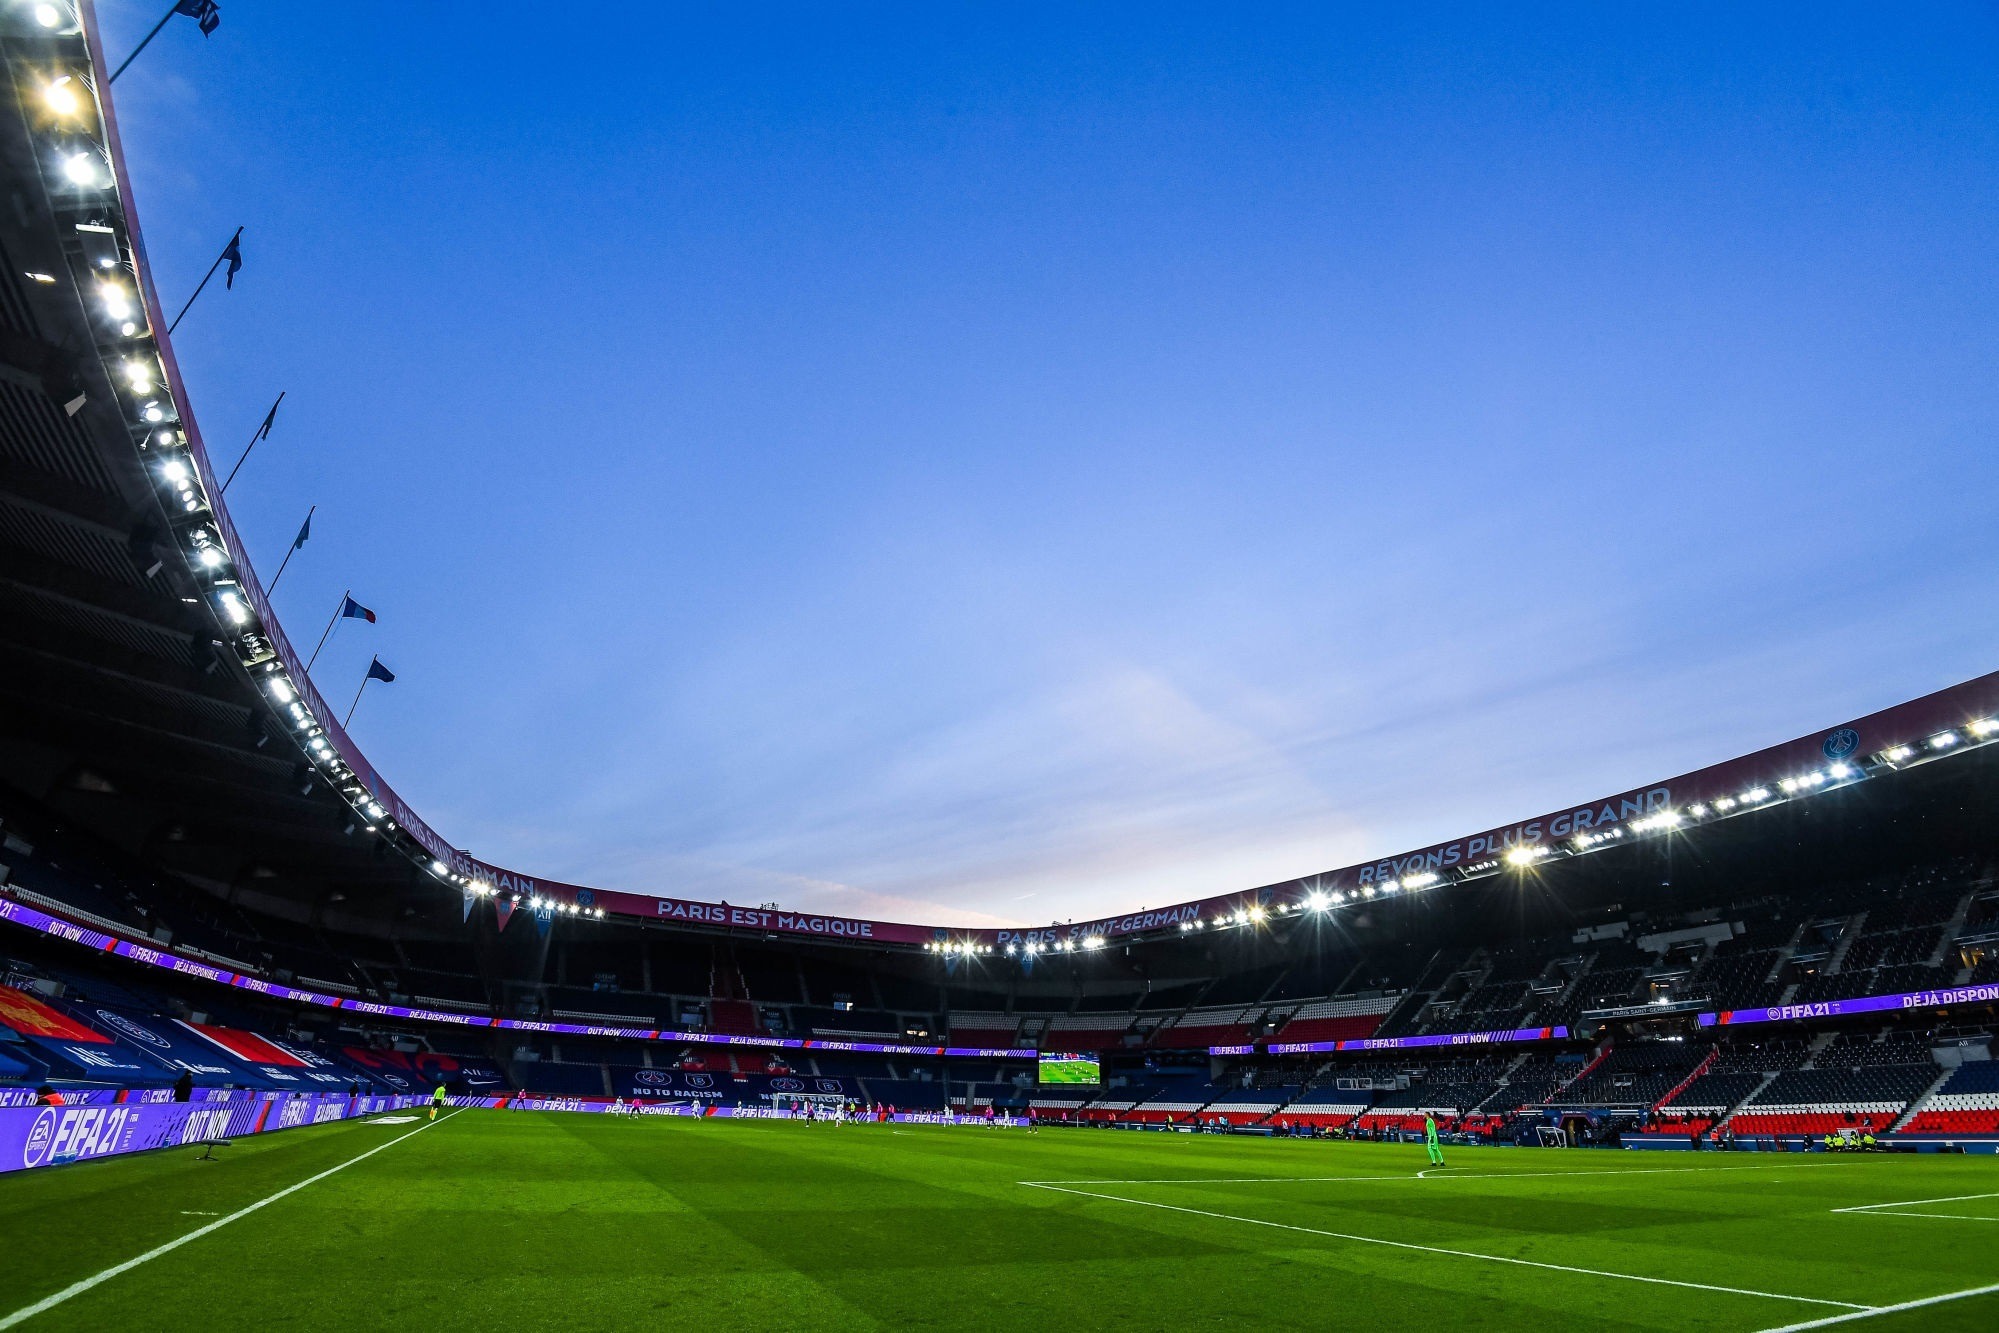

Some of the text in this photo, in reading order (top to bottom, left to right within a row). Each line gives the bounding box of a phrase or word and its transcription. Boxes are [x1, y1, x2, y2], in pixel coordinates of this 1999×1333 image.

[398, 802, 425, 842] PARIS
[1358, 788, 1671, 884] RÊVONS PLUS GRAND
[657, 901, 873, 937] PARIS EST MAGIQUE
[997, 904, 1200, 944] PARIS SAINT-GERMAIN
[48, 921, 83, 942] OUT NOW
[188, 963, 220, 981] DISPONIBLE
[288, 991, 313, 1003] OUT NOW
[1903, 992, 1941, 1009] DÉJÀ
[427, 1013, 470, 1025] DISPONIBLE
[587, 1027, 621, 1037] OUT NOW
[1452, 1034, 1490, 1044] OUT NOW
[747, 1038, 784, 1047] DISPONIBLE
[883, 1045, 912, 1054] OUT NOW
[633, 1087, 723, 1098] NO TO RACISM
[181, 1108, 234, 1144] OUT NOW
